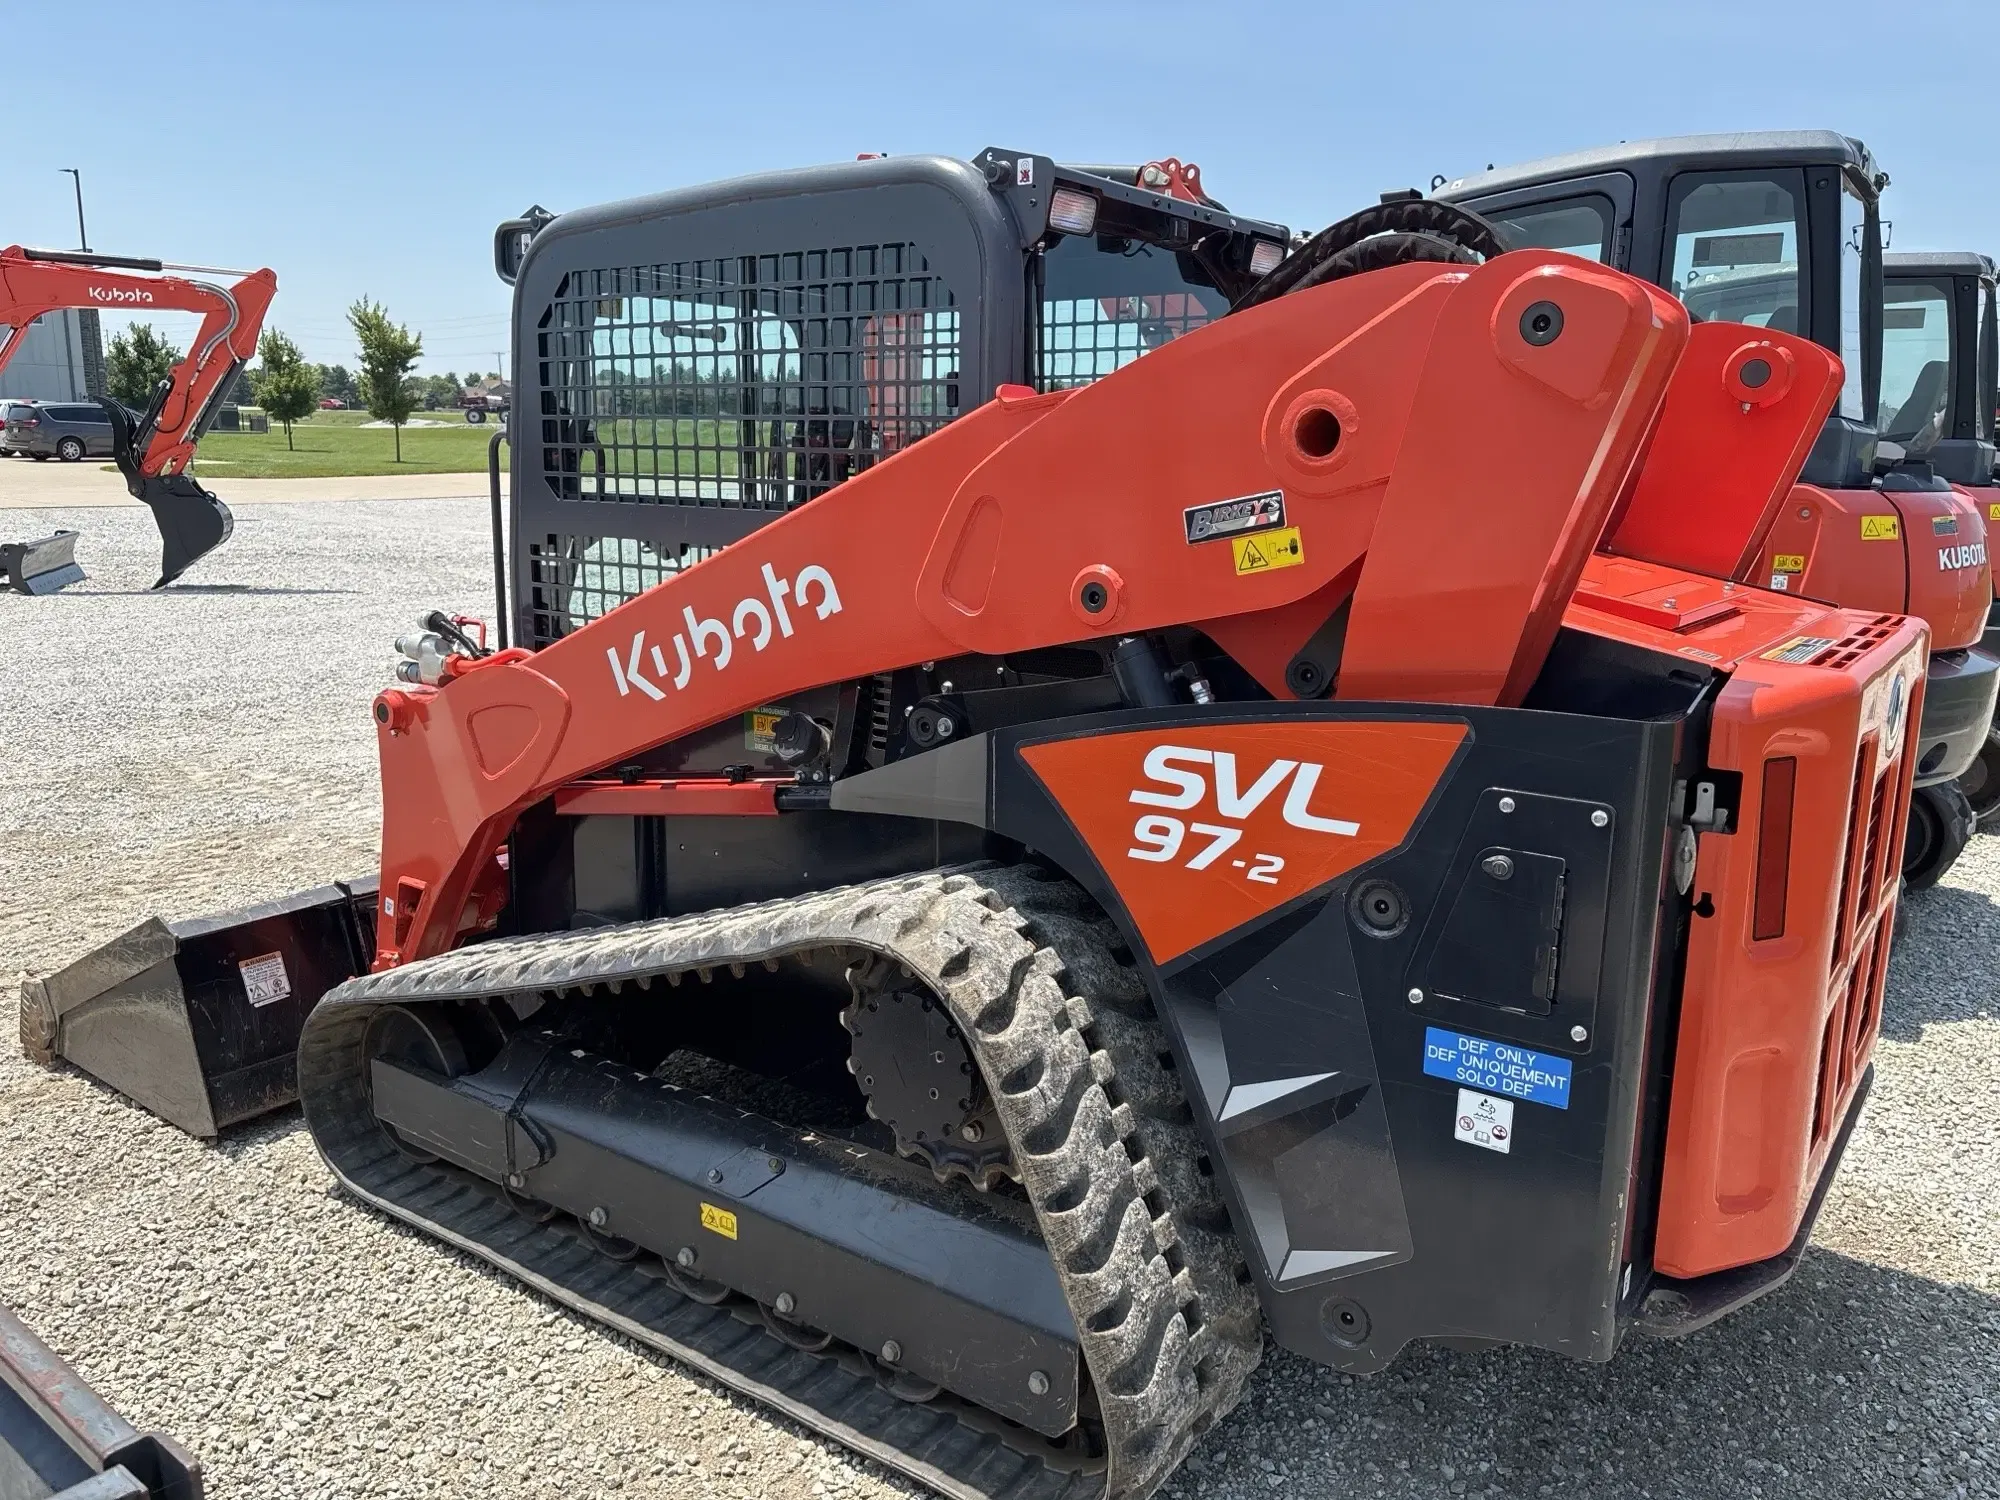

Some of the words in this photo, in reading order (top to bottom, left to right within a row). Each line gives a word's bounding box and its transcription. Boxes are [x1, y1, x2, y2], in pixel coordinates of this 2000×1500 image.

[88, 287, 153, 302] Kubota
[1188, 495, 1281, 541] BIRKEY'S
[1938, 543, 1987, 571] KUBOTA
[606, 562, 843, 701] Kubota
[1128, 744, 1361, 837] SVL
[1127, 815, 1285, 885] 97-2
[1427, 1045, 1457, 1063] DEF
[1462, 1054, 1568, 1090] UNIQUEMENT
[1458, 1037, 1489, 1055] DEF
[1495, 1047, 1536, 1067] ONLY
[1456, 1067, 1497, 1088] SOLO
[1502, 1078, 1535, 1097] DEF
